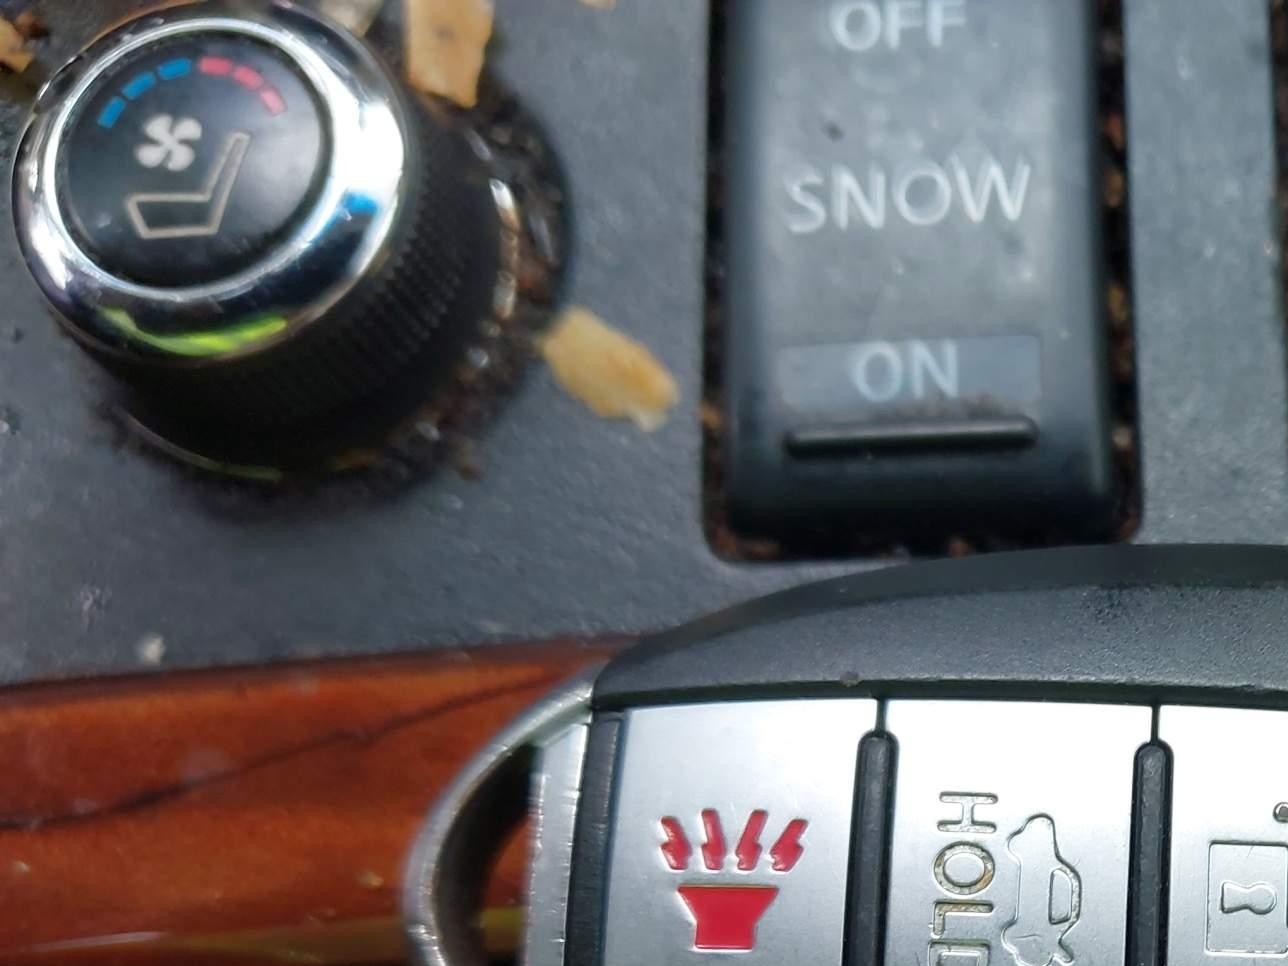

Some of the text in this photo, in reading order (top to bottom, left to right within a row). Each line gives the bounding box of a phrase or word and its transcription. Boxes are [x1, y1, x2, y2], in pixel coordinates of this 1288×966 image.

[831, 0, 968, 51] OFF
[786, 153, 1032, 234] SNOW
[851, 339, 960, 402] ON
